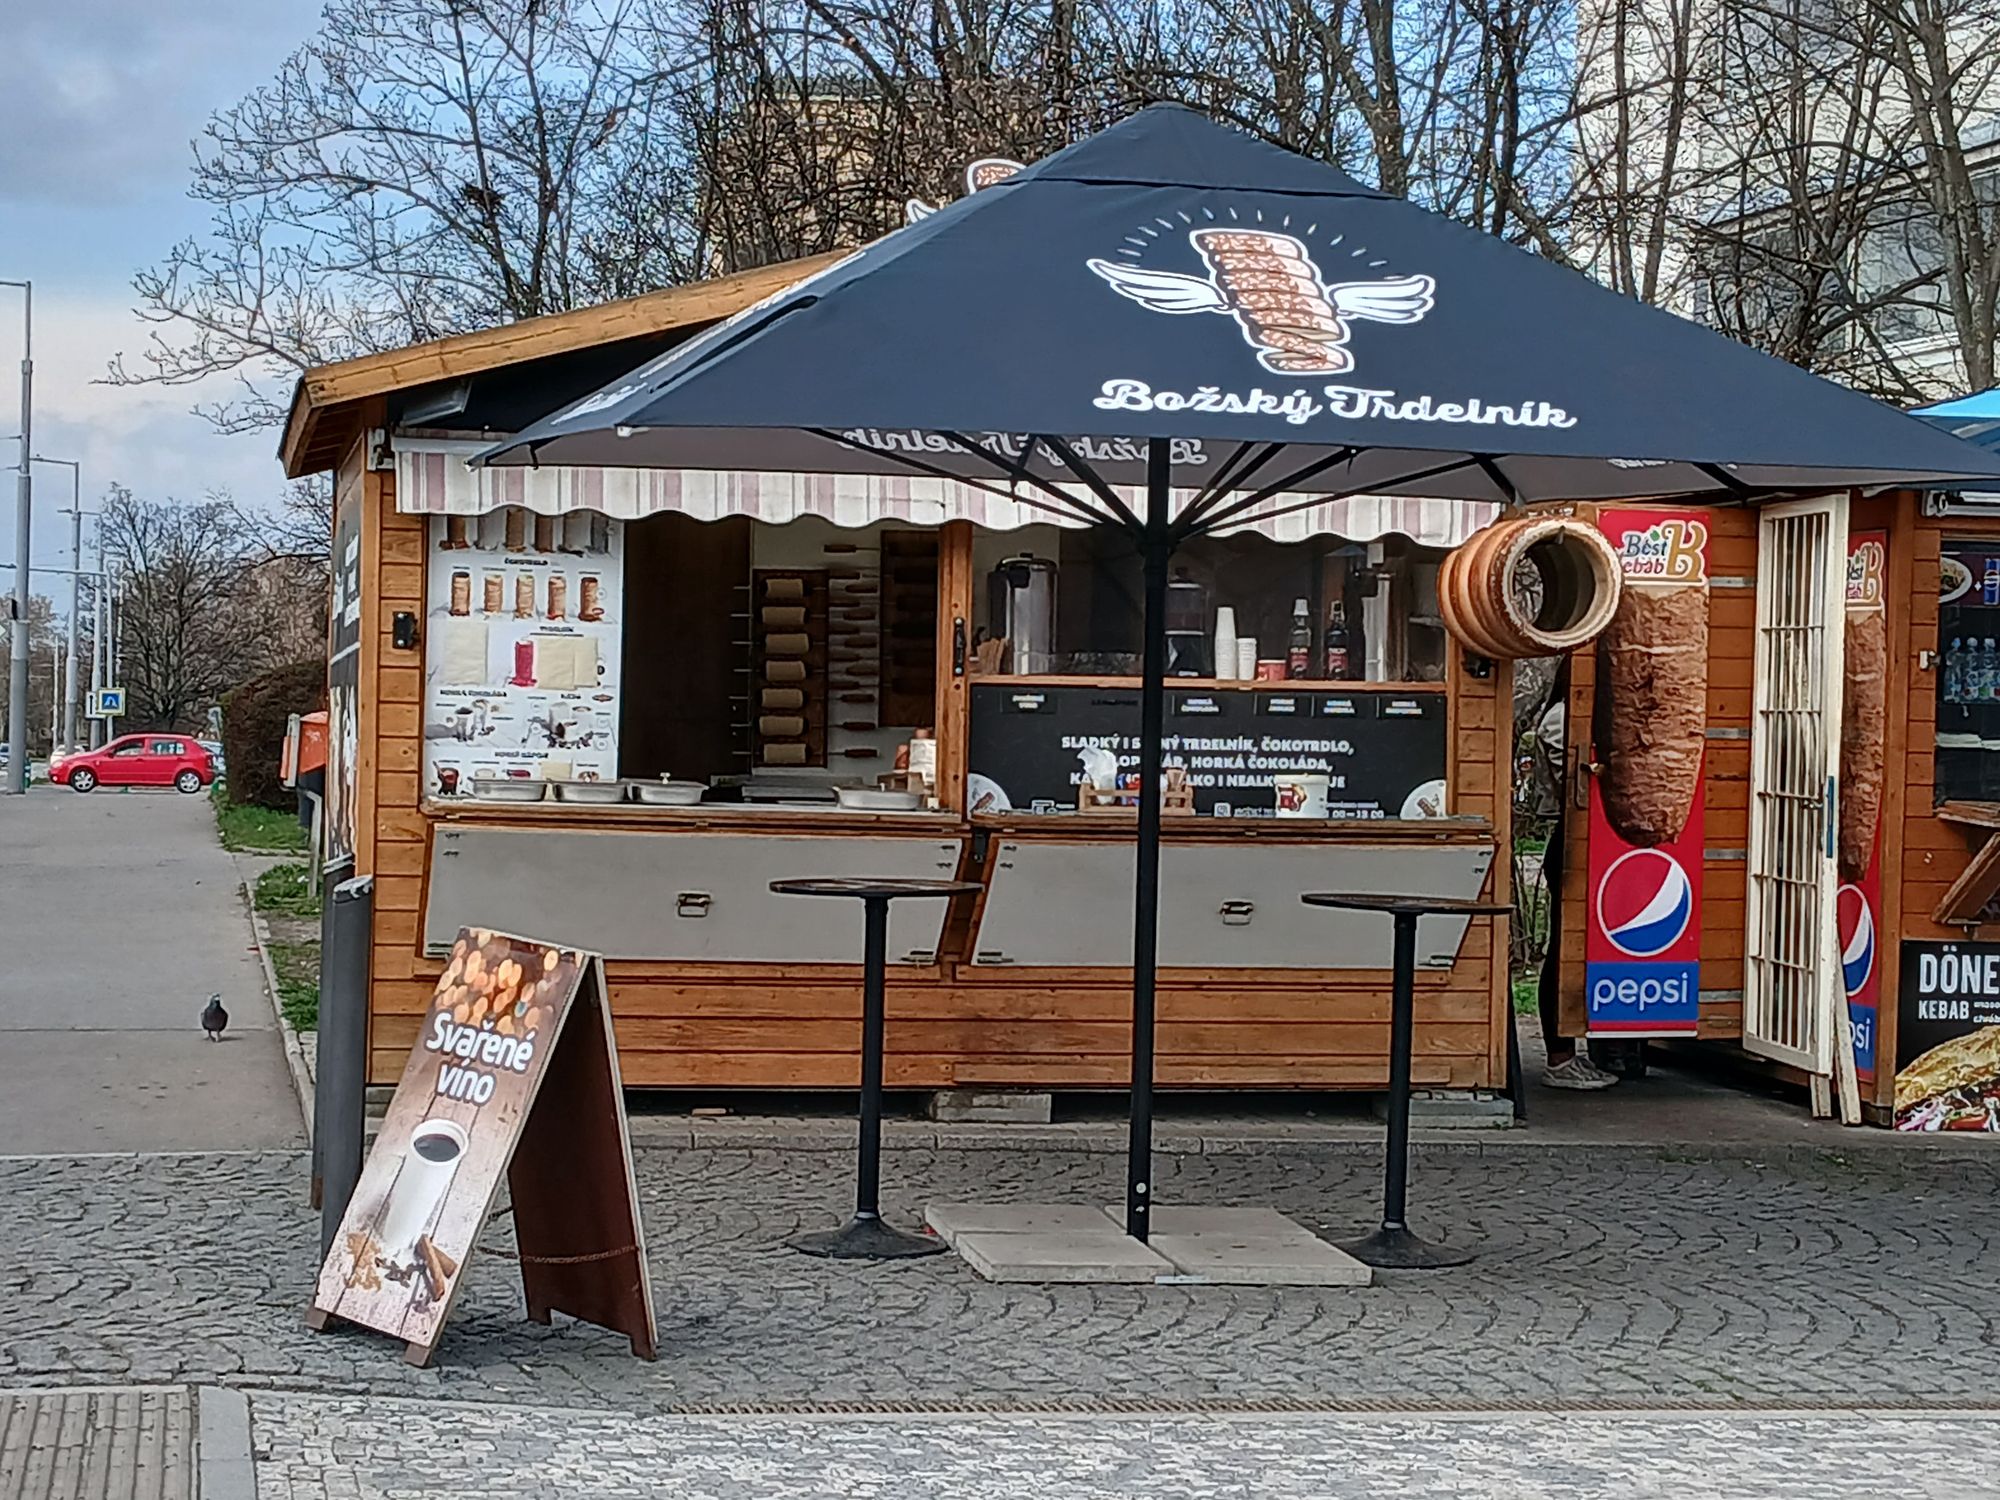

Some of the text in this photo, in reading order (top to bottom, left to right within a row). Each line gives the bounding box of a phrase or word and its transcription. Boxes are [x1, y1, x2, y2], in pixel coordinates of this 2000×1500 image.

[1093, 379, 1577, 428] Božský Trdelník
[1623, 534, 1668, 557] Best
[1621, 557, 1665, 575] ebab
[1061, 733, 1354, 755] SLADKÝ I SNÝ TRDELNÍK, ČOKOTRDLO,
[1191, 754, 1245, 769] HORKÁ
[1247, 754, 1333, 772] ČOKOLÁDA,
[1226, 775, 1276, 788] NEALK
[1919, 945, 2000, 994] DÖNE
[1593, 972, 1688, 1012] pepsi
[1918, 1000, 1969, 1019] KEBAB
[426, 1012, 536, 1071] Svařené
[437, 1058, 495, 1103] víno
